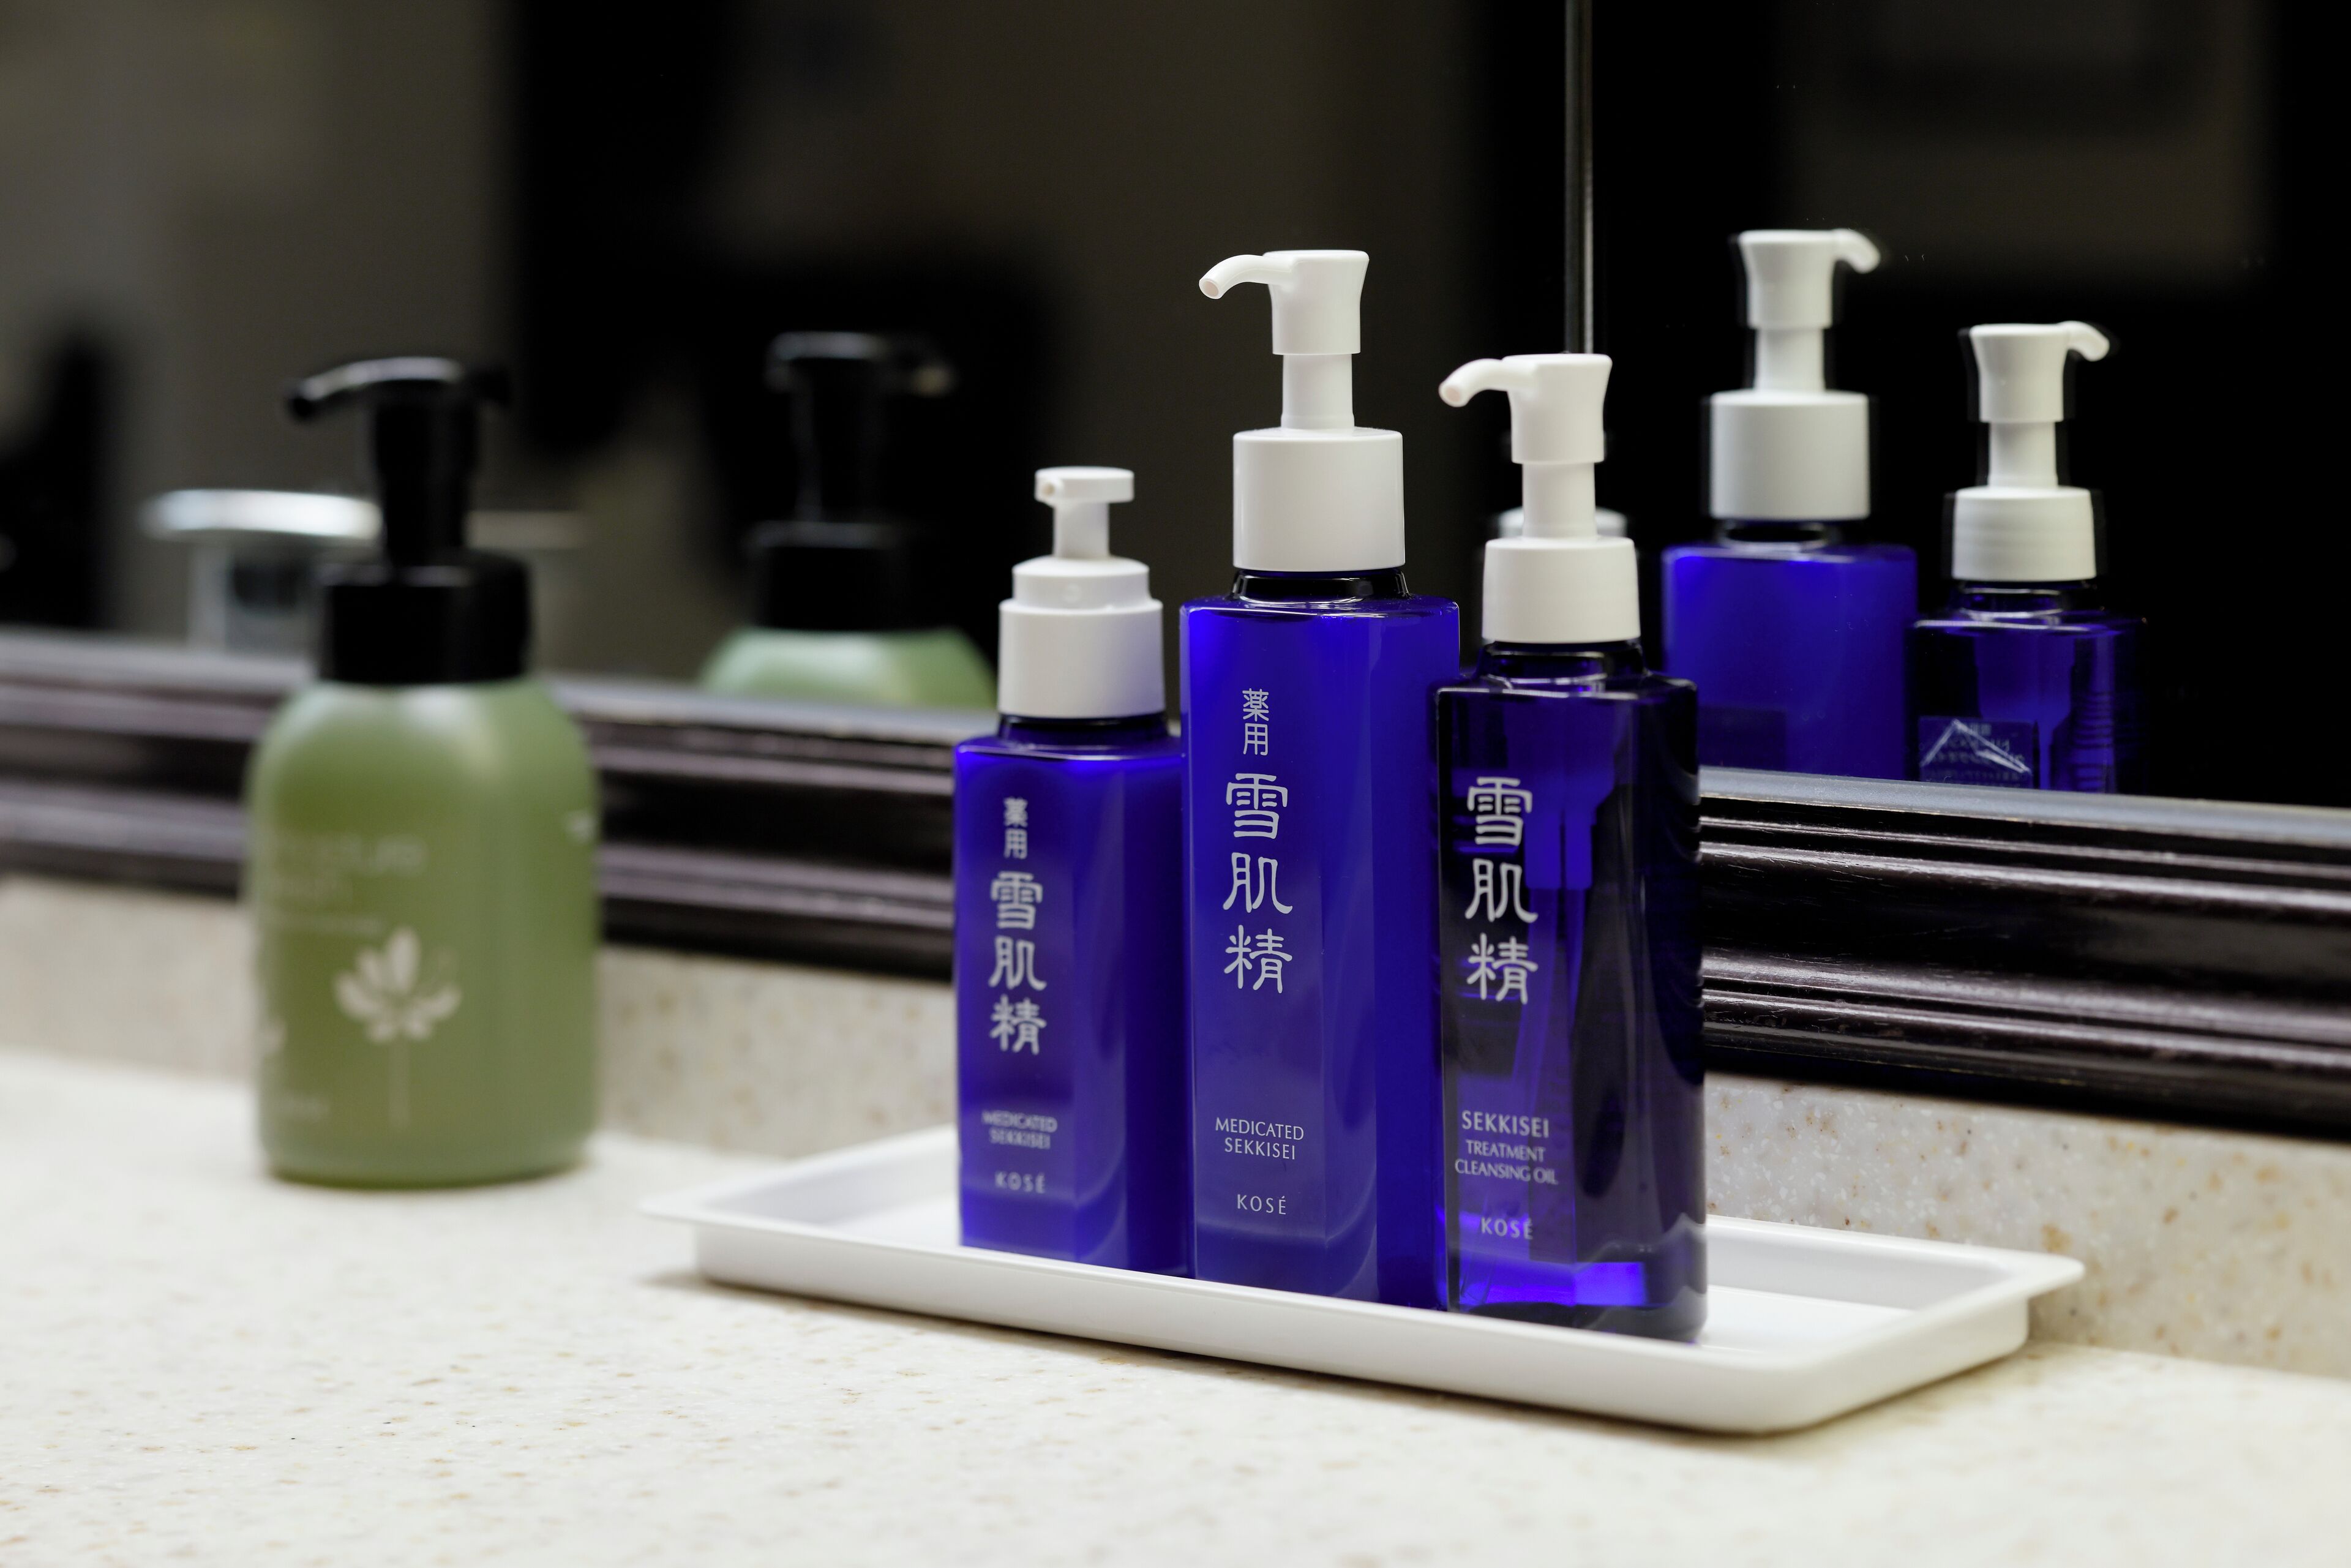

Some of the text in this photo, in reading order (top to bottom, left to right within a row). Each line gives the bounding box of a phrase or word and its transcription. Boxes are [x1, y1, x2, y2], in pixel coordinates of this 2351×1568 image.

[1242, 688, 1269, 756] 薬用
[1223, 773, 1293, 993] 雪肌精
[1465, 777, 1538, 1004] 雪肌精
[989, 871, 1047, 1055] 雪肌精
[1215, 1117, 1304, 1140] MEDICATED
[1461, 1110, 1549, 1138] SEKKISEI
[1224, 1137, 1295, 1160] SEKKISEI
[1466, 1139, 1545, 1162] TREATMENT
[1455, 1158, 1559, 1185] CLEANSING OIL
[1237, 1194, 1286, 1215] KOSÉ
